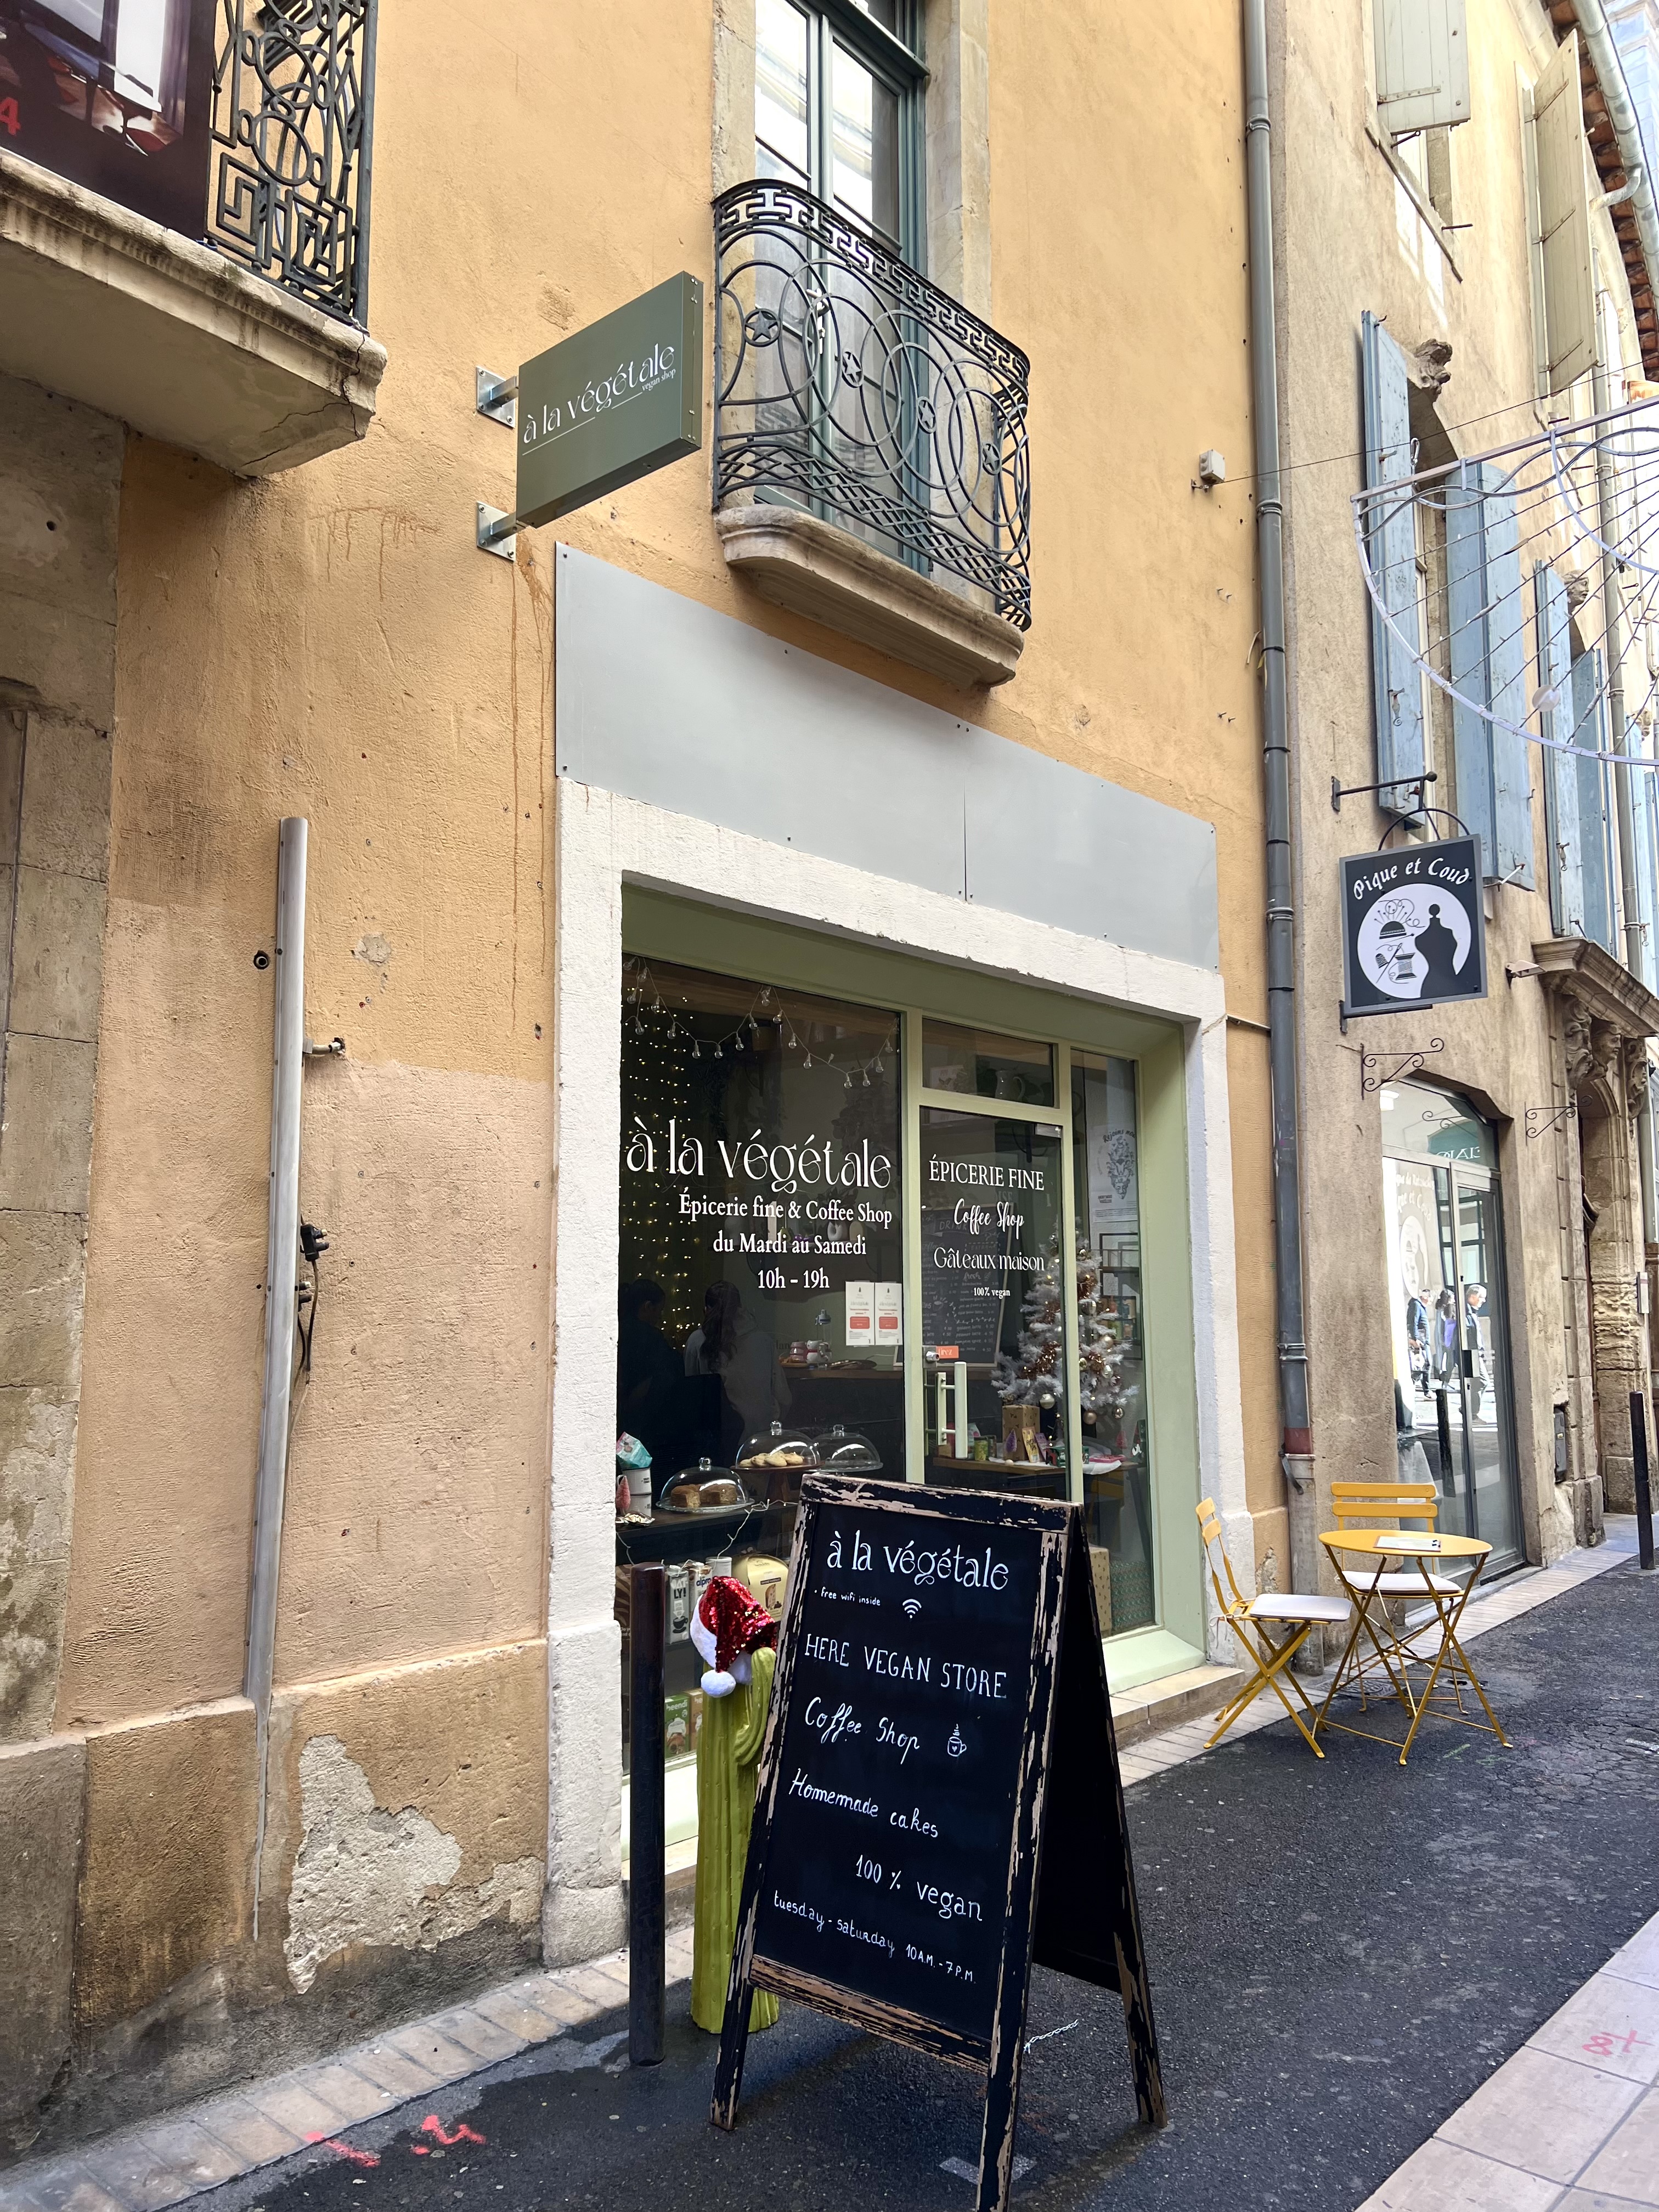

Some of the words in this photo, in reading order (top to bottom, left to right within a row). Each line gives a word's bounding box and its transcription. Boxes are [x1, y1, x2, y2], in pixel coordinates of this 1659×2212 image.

[524, 415, 537, 443] à
[543, 404, 561, 435] la
[567, 343, 675, 419] végétale
[642, 376, 660, 391] vegan
[661, 368, 676, 383] shop
[1353, 865, 1397, 900] Pique
[1405, 857, 1421, 875] et
[1428, 857, 1470, 885] Coud
[627, 1116, 654, 1173] à
[668, 1119, 704, 1176] la
[717, 1128, 891, 1194] végétale
[929, 1154, 1004, 1187] ÉPICERIE
[1008, 1169, 1045, 1190] FINE
[679, 1187, 748, 1222] Épicerie
[753, 1195, 783, 1219] fine
[788, 1200, 801, 1220] &
[806, 1200, 854, 1222] Coffee
[858, 1204, 892, 1229] Shop
[954, 1198, 991, 1235] Coffee
[996, 1201, 1024, 1239] Shop
[713, 1231, 734, 1252] du
[739, 1233, 787, 1254] Mardi
[792, 1238, 809, 1254] au
[814, 1235, 866, 1255] Samedi
[934, 1247, 996, 1270] Gâteaux
[998, 1251, 1045, 1271] maison
[758, 1267, 786, 1289] 10h
[803, 1267, 830, 1289] 19h
[973, 1287, 990, 1297] 100%
[991, 1289, 1011, 1300] vegan
[827, 1531, 842, 1568] à
[851, 1530, 873, 1571] la
[883, 1540, 1009, 1590] végétale
[674, 1588, 686, 1599] LY!
[821, 1587, 837, 1600] free
[841, 1591, 855, 1602] wifi
[859, 1594, 881, 1606] inside
[804, 1633, 849, 1667] HERE
[865, 1646, 931, 1683] VEGAN
[940, 1662, 1007, 1699] STORE
[805, 1697, 862, 1743] Coffee
[876, 1717, 920, 1764] Shop
[789, 1768, 879, 1817] Homemade
[890, 1808, 939, 1838] cakes
[856, 1854, 882, 1883] 100
[917, 1881, 982, 1921] vegan
[774, 1890, 825, 1932] tuesday
[837, 1919, 895, 1957] saturday
